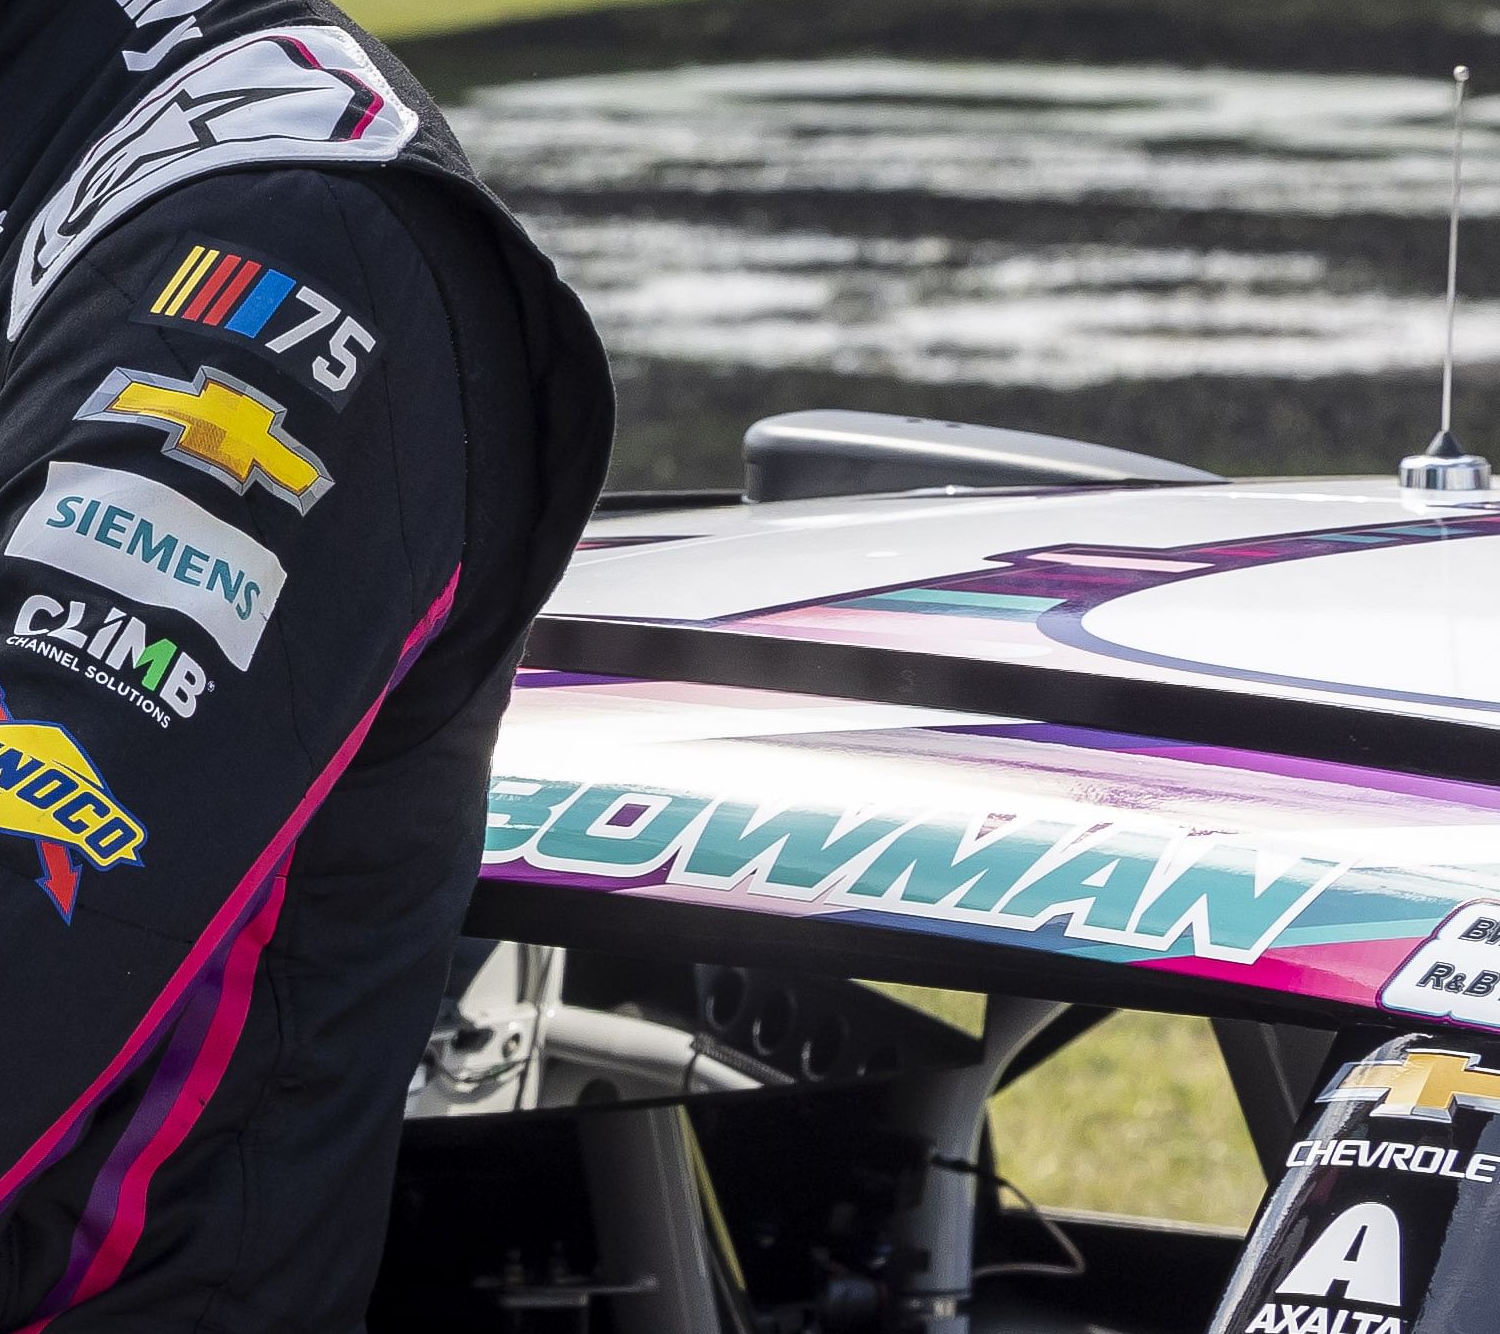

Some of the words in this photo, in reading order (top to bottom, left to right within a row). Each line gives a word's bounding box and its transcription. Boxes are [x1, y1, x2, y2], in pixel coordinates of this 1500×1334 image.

[265, 286, 376, 392] 75
[46, 495, 261, 622] SIEMENS
[6, 636, 80, 672] CHANNEL
[85, 665, 171, 729] SOLUTIONS
[14, 594, 206, 718] CLIMB
[1285, 1139, 1500, 1183] CHEVROLE
